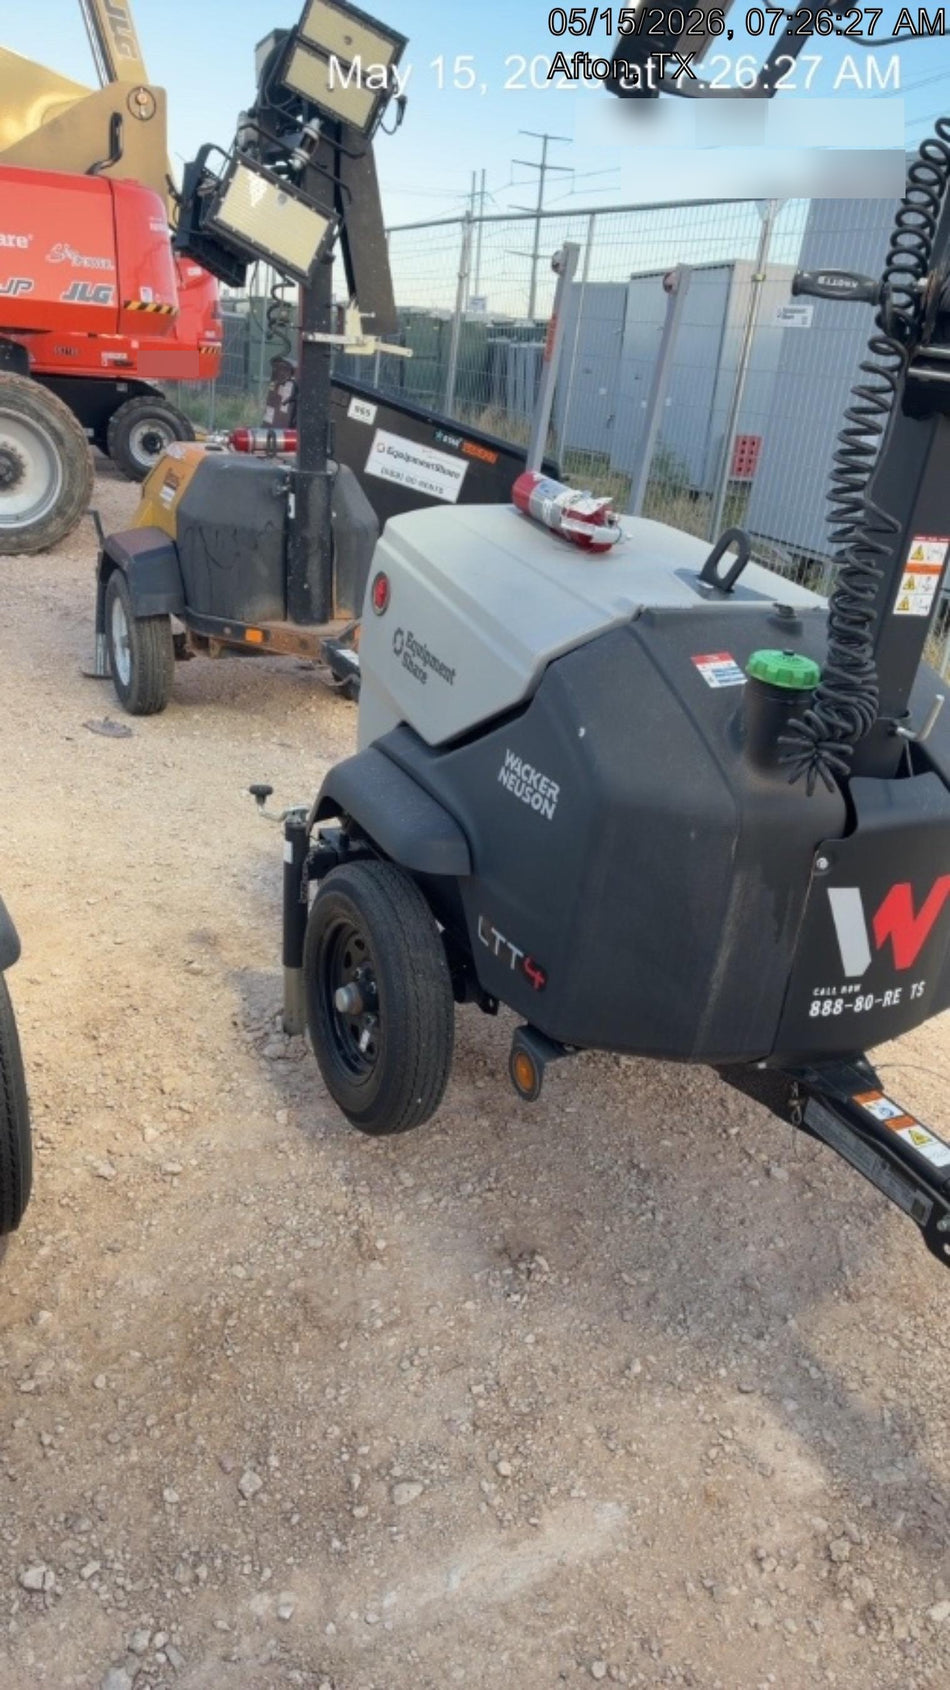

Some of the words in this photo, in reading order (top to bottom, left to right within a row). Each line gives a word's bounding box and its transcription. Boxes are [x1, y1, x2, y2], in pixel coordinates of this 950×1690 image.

[61, 281, 116, 306] JLG
[402, 651, 427, 685] Share
[405, 631, 456, 686] Equipment
[497, 765, 556, 821] NEUSON
[504, 748, 561, 803] WACKER
[813, 986, 837, 996] CALL
